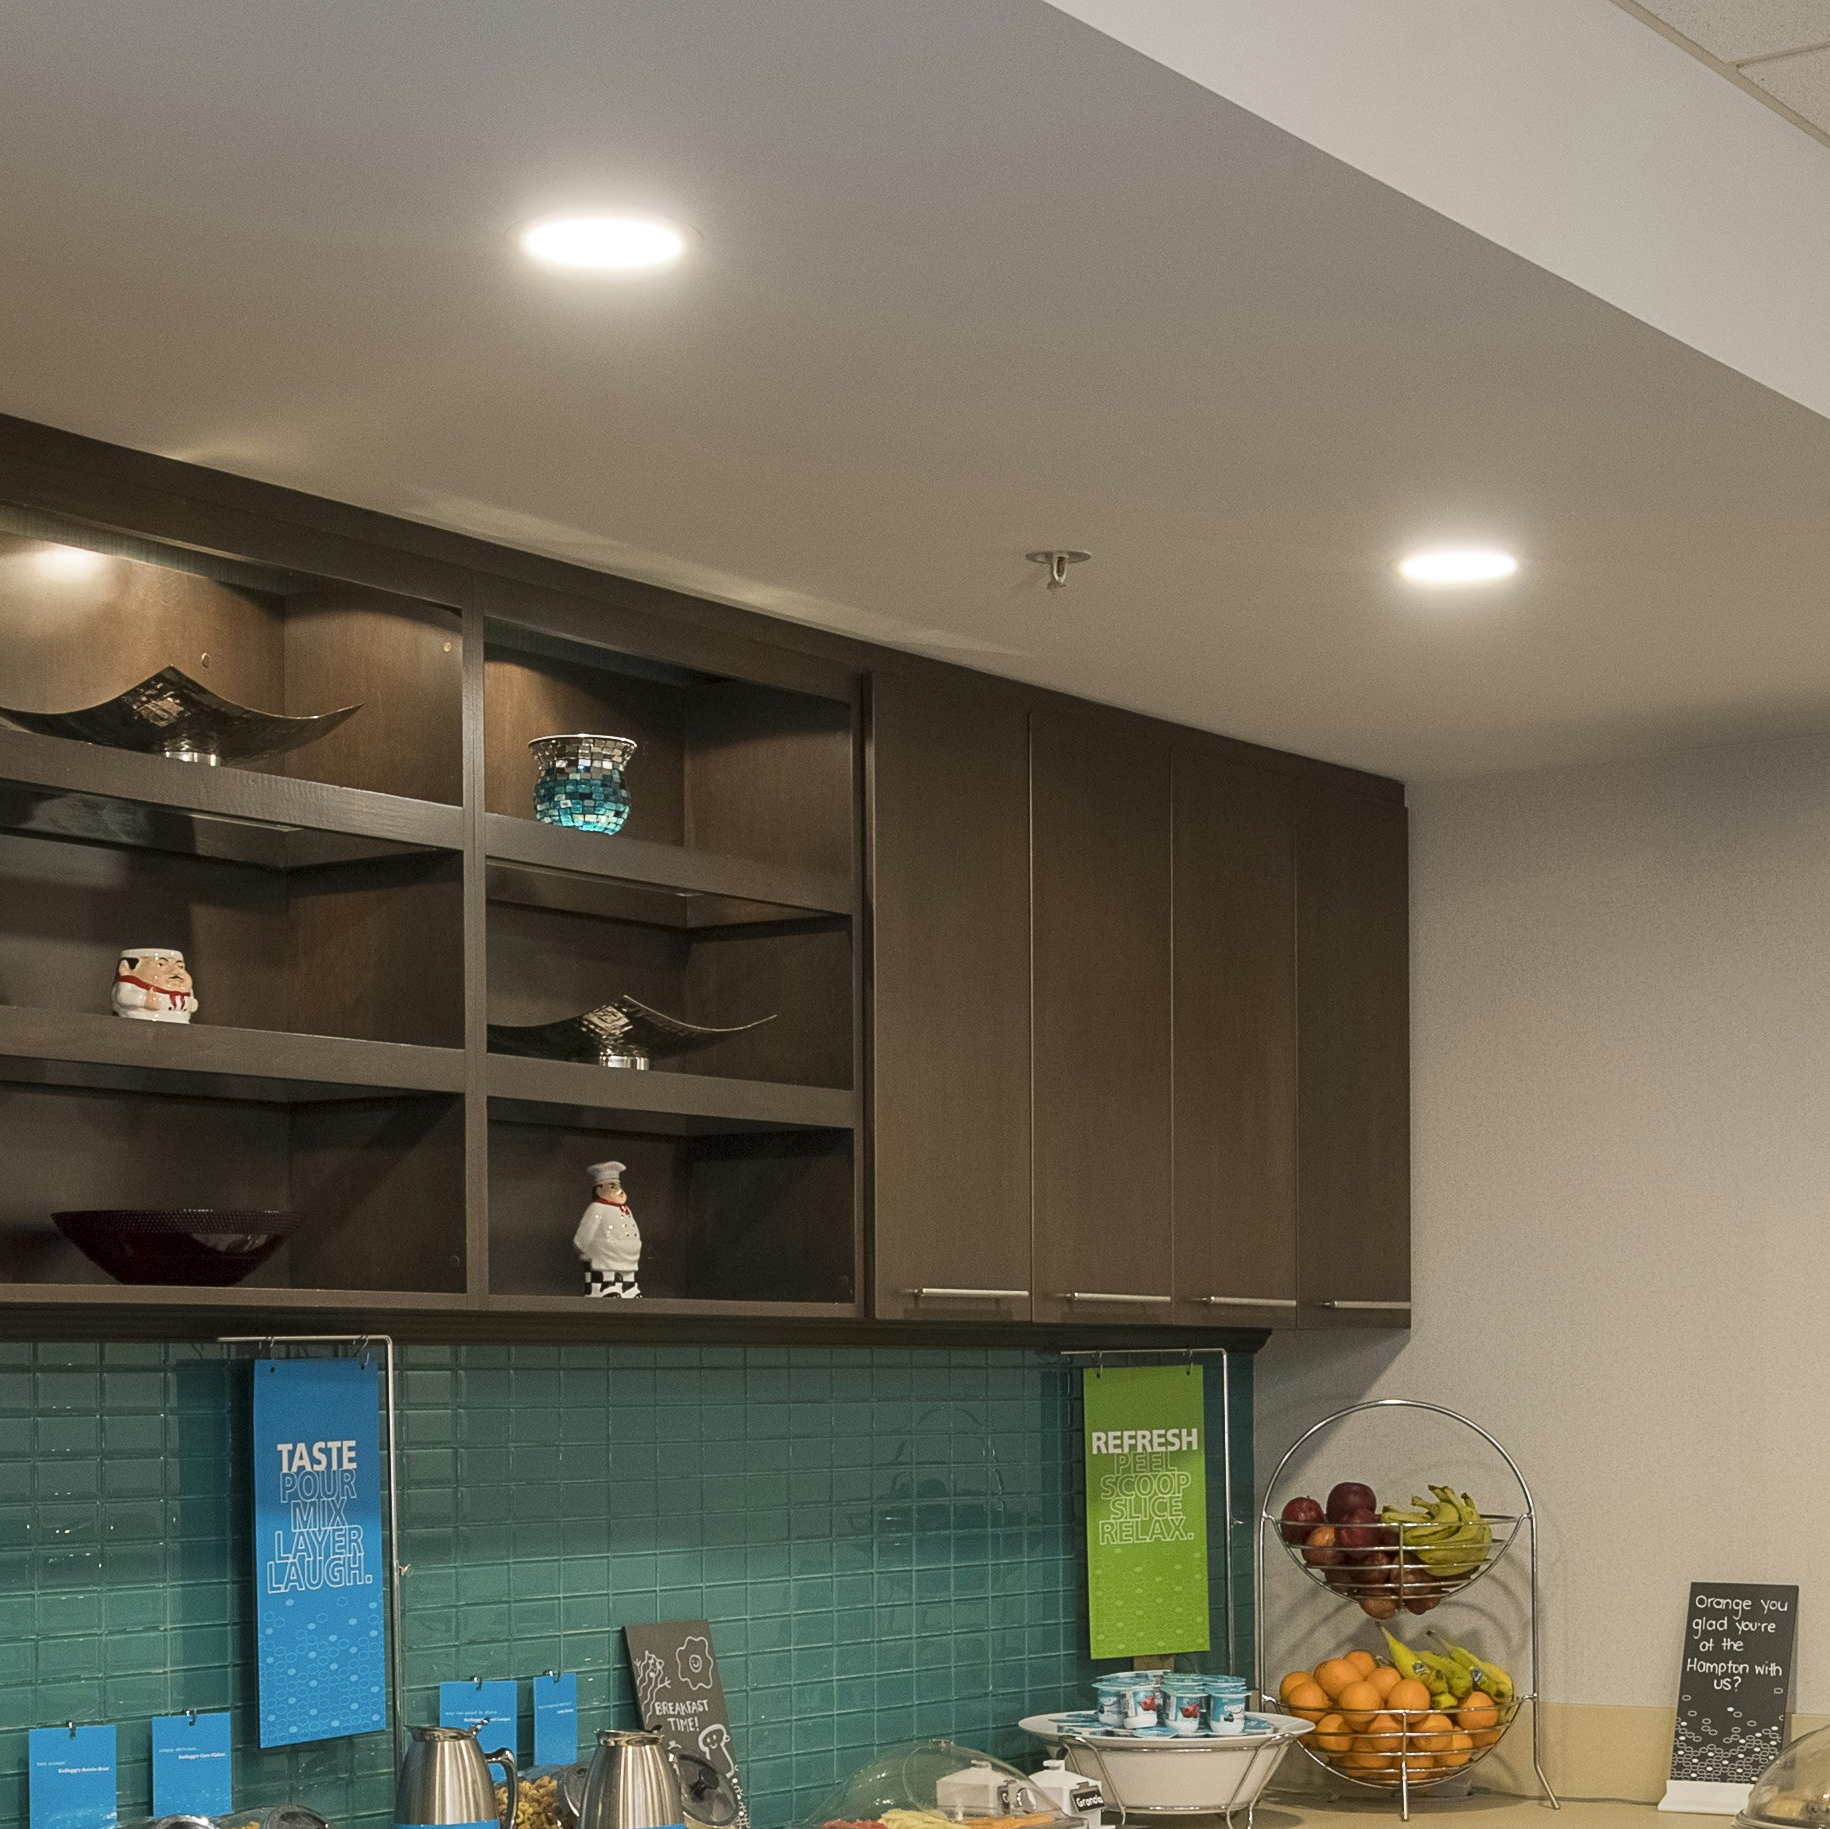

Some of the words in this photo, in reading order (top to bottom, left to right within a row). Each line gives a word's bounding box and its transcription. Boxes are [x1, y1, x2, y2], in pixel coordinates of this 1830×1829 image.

[1091, 1428, 1198, 1454] REFRESH
[277, 1440, 358, 1473] TASTE
[1114, 1450, 1177, 1475] PEEL
[281, 1468, 356, 1503] POUR
[1101, 1471, 1191, 1500] SCOOP
[290, 1497, 349, 1532] MIX
[1110, 1495, 1183, 1521] SLICE
[1099, 1516, 1195, 1545] RELAX.
[274, 1525, 364, 1563] LAYER
[267, 1555, 373, 1594] LAUGH.
[1695, 1595, 1752, 1620] Orange
[1760, 1599, 1788, 1614] you
[1692, 1616, 1728, 1639] glad
[1735, 1620, 1776, 1635] you're
[1699, 1638, 1715, 1652] at
[1721, 1637, 1744, 1652] the
[1686, 1657, 1749, 1676] Hampton
[1755, 1661, 1782, 1677] with
[1713, 1675, 1742, 1692] us?
[654, 1699, 709, 1715] BREAKFAST
[666, 1716, 700, 1732] TIME!
